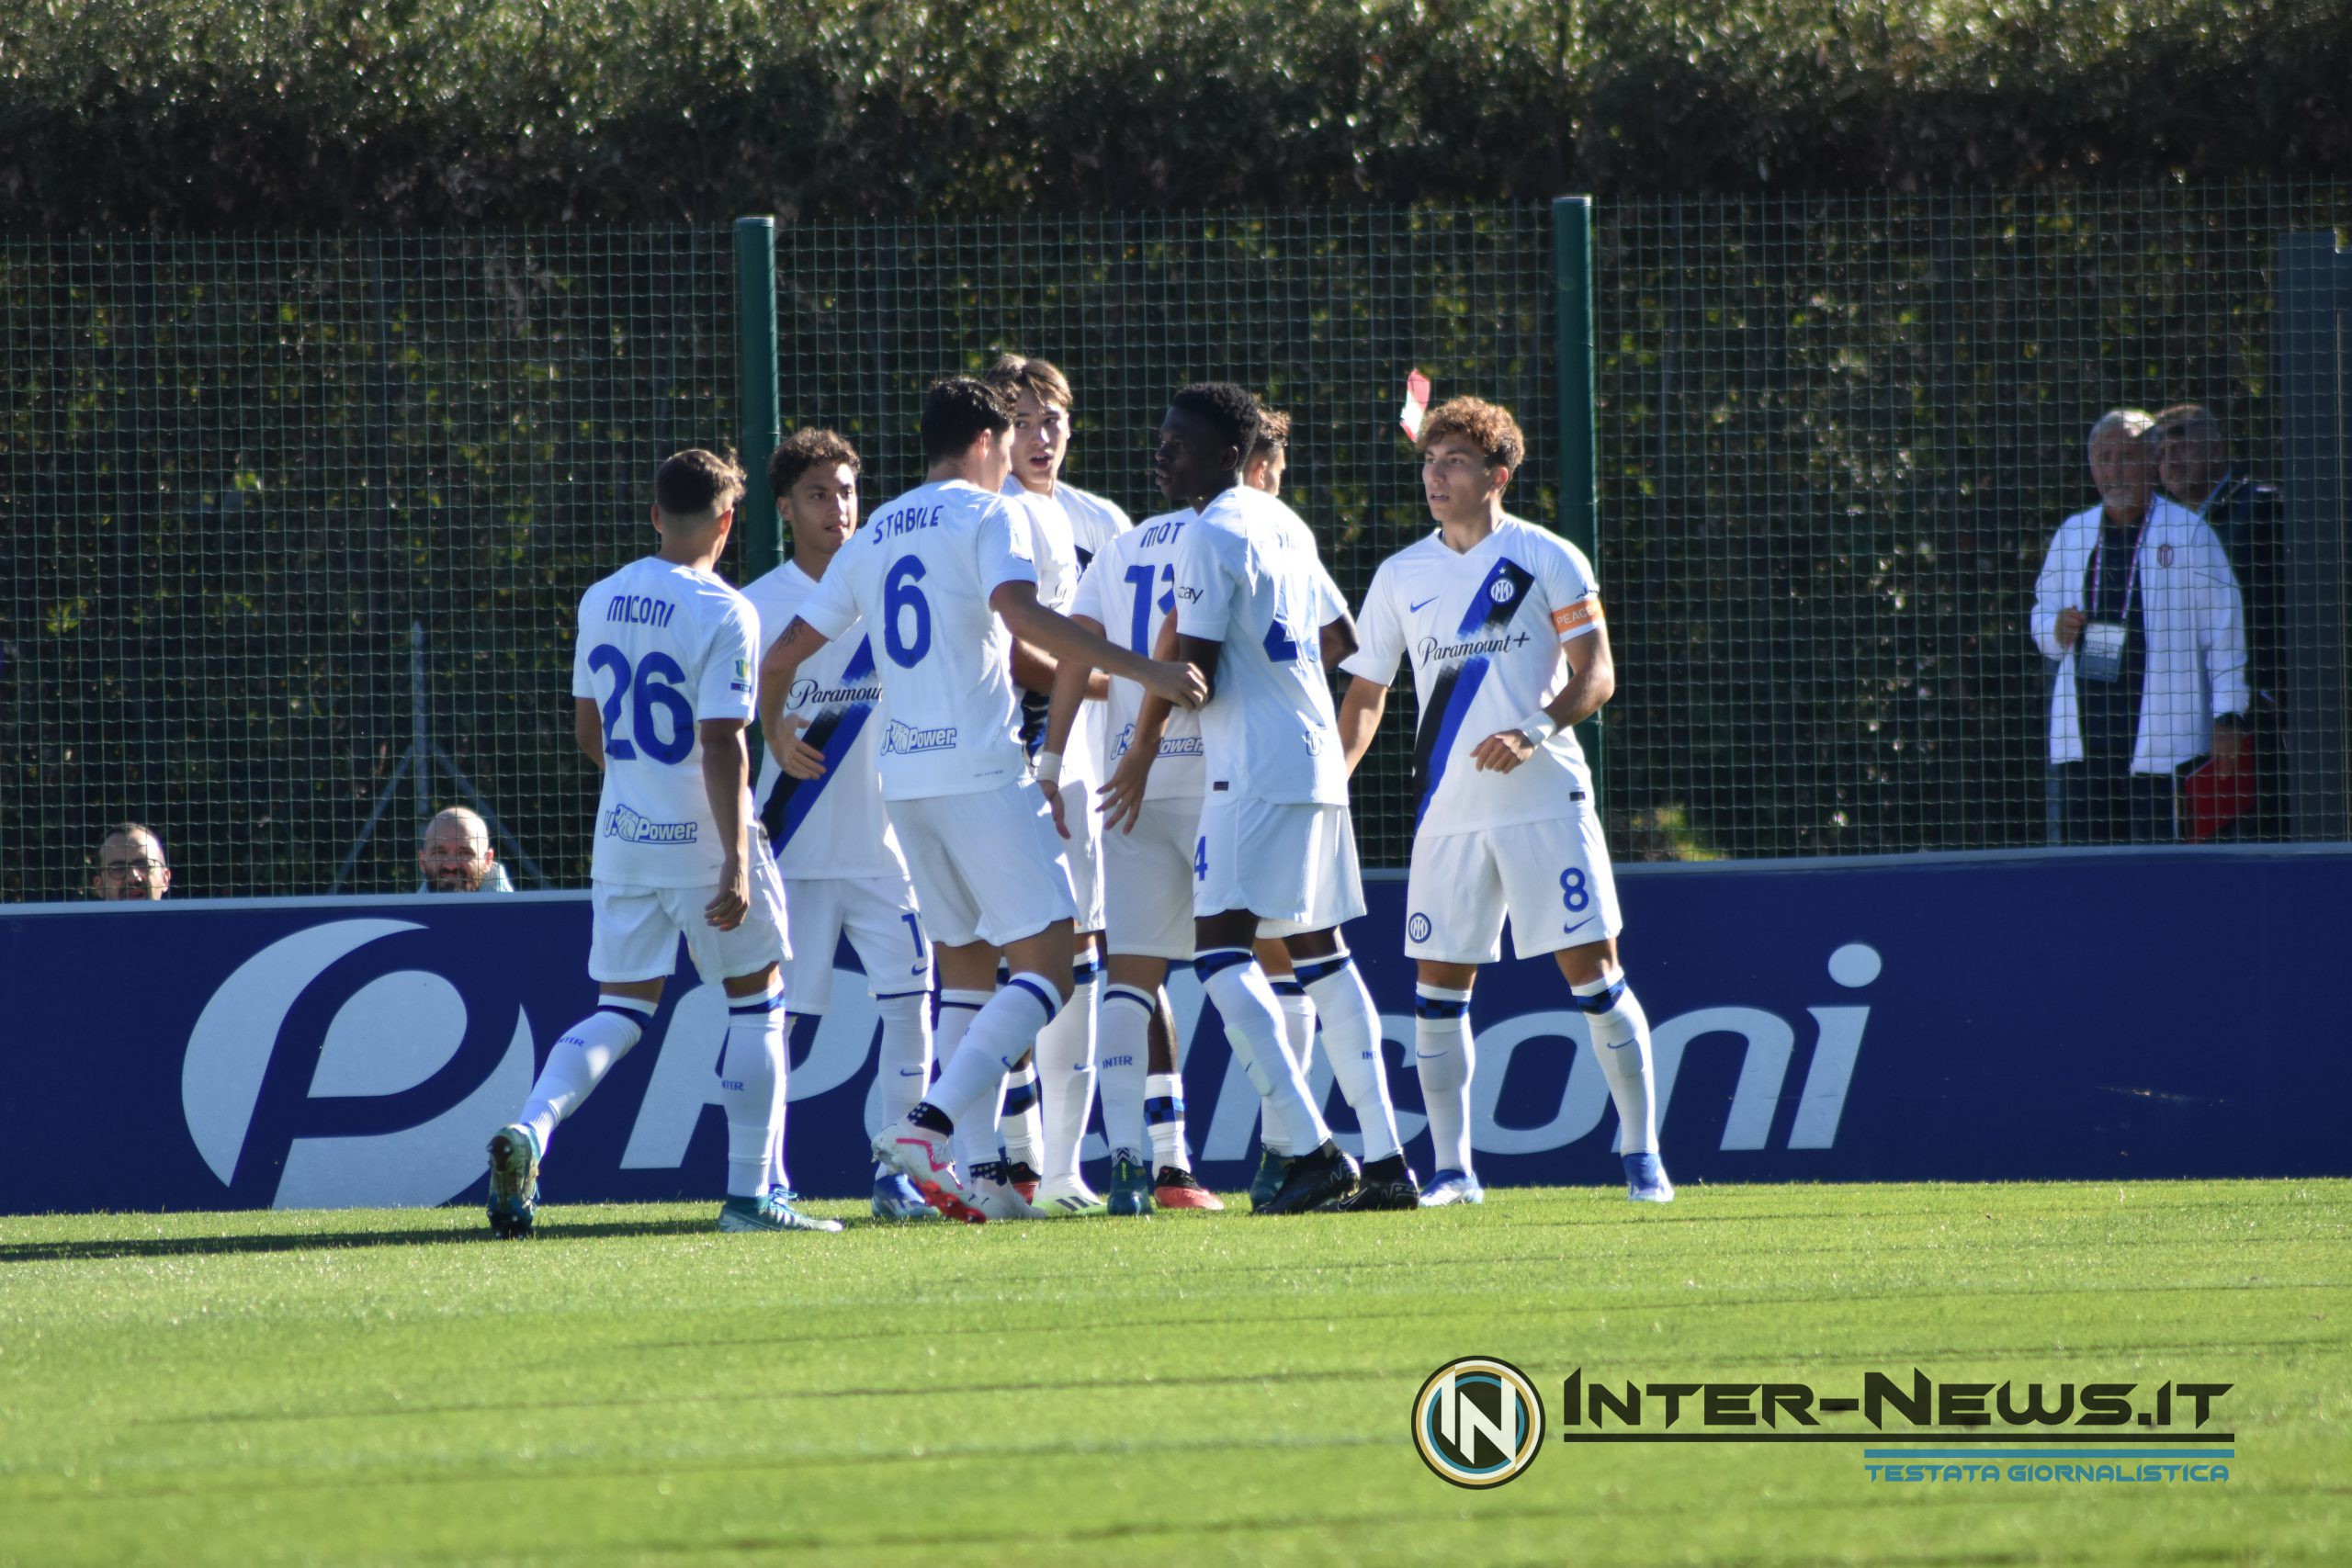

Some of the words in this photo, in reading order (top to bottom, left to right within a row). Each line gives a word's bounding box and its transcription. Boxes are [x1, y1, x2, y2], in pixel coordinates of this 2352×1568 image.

[873, 505, 944, 545] STABILE
[1140, 522, 1185, 547] MOT
[606, 595, 675, 628] MICONI
[884, 554, 932, 670] 6
[1556, 607, 1593, 626] PEACE
[1418, 631, 1531, 671] Paramount+
[587, 643, 695, 766] 26
[786, 679, 882, 711] Paramou
[1559, 867, 1589, 913] 8
